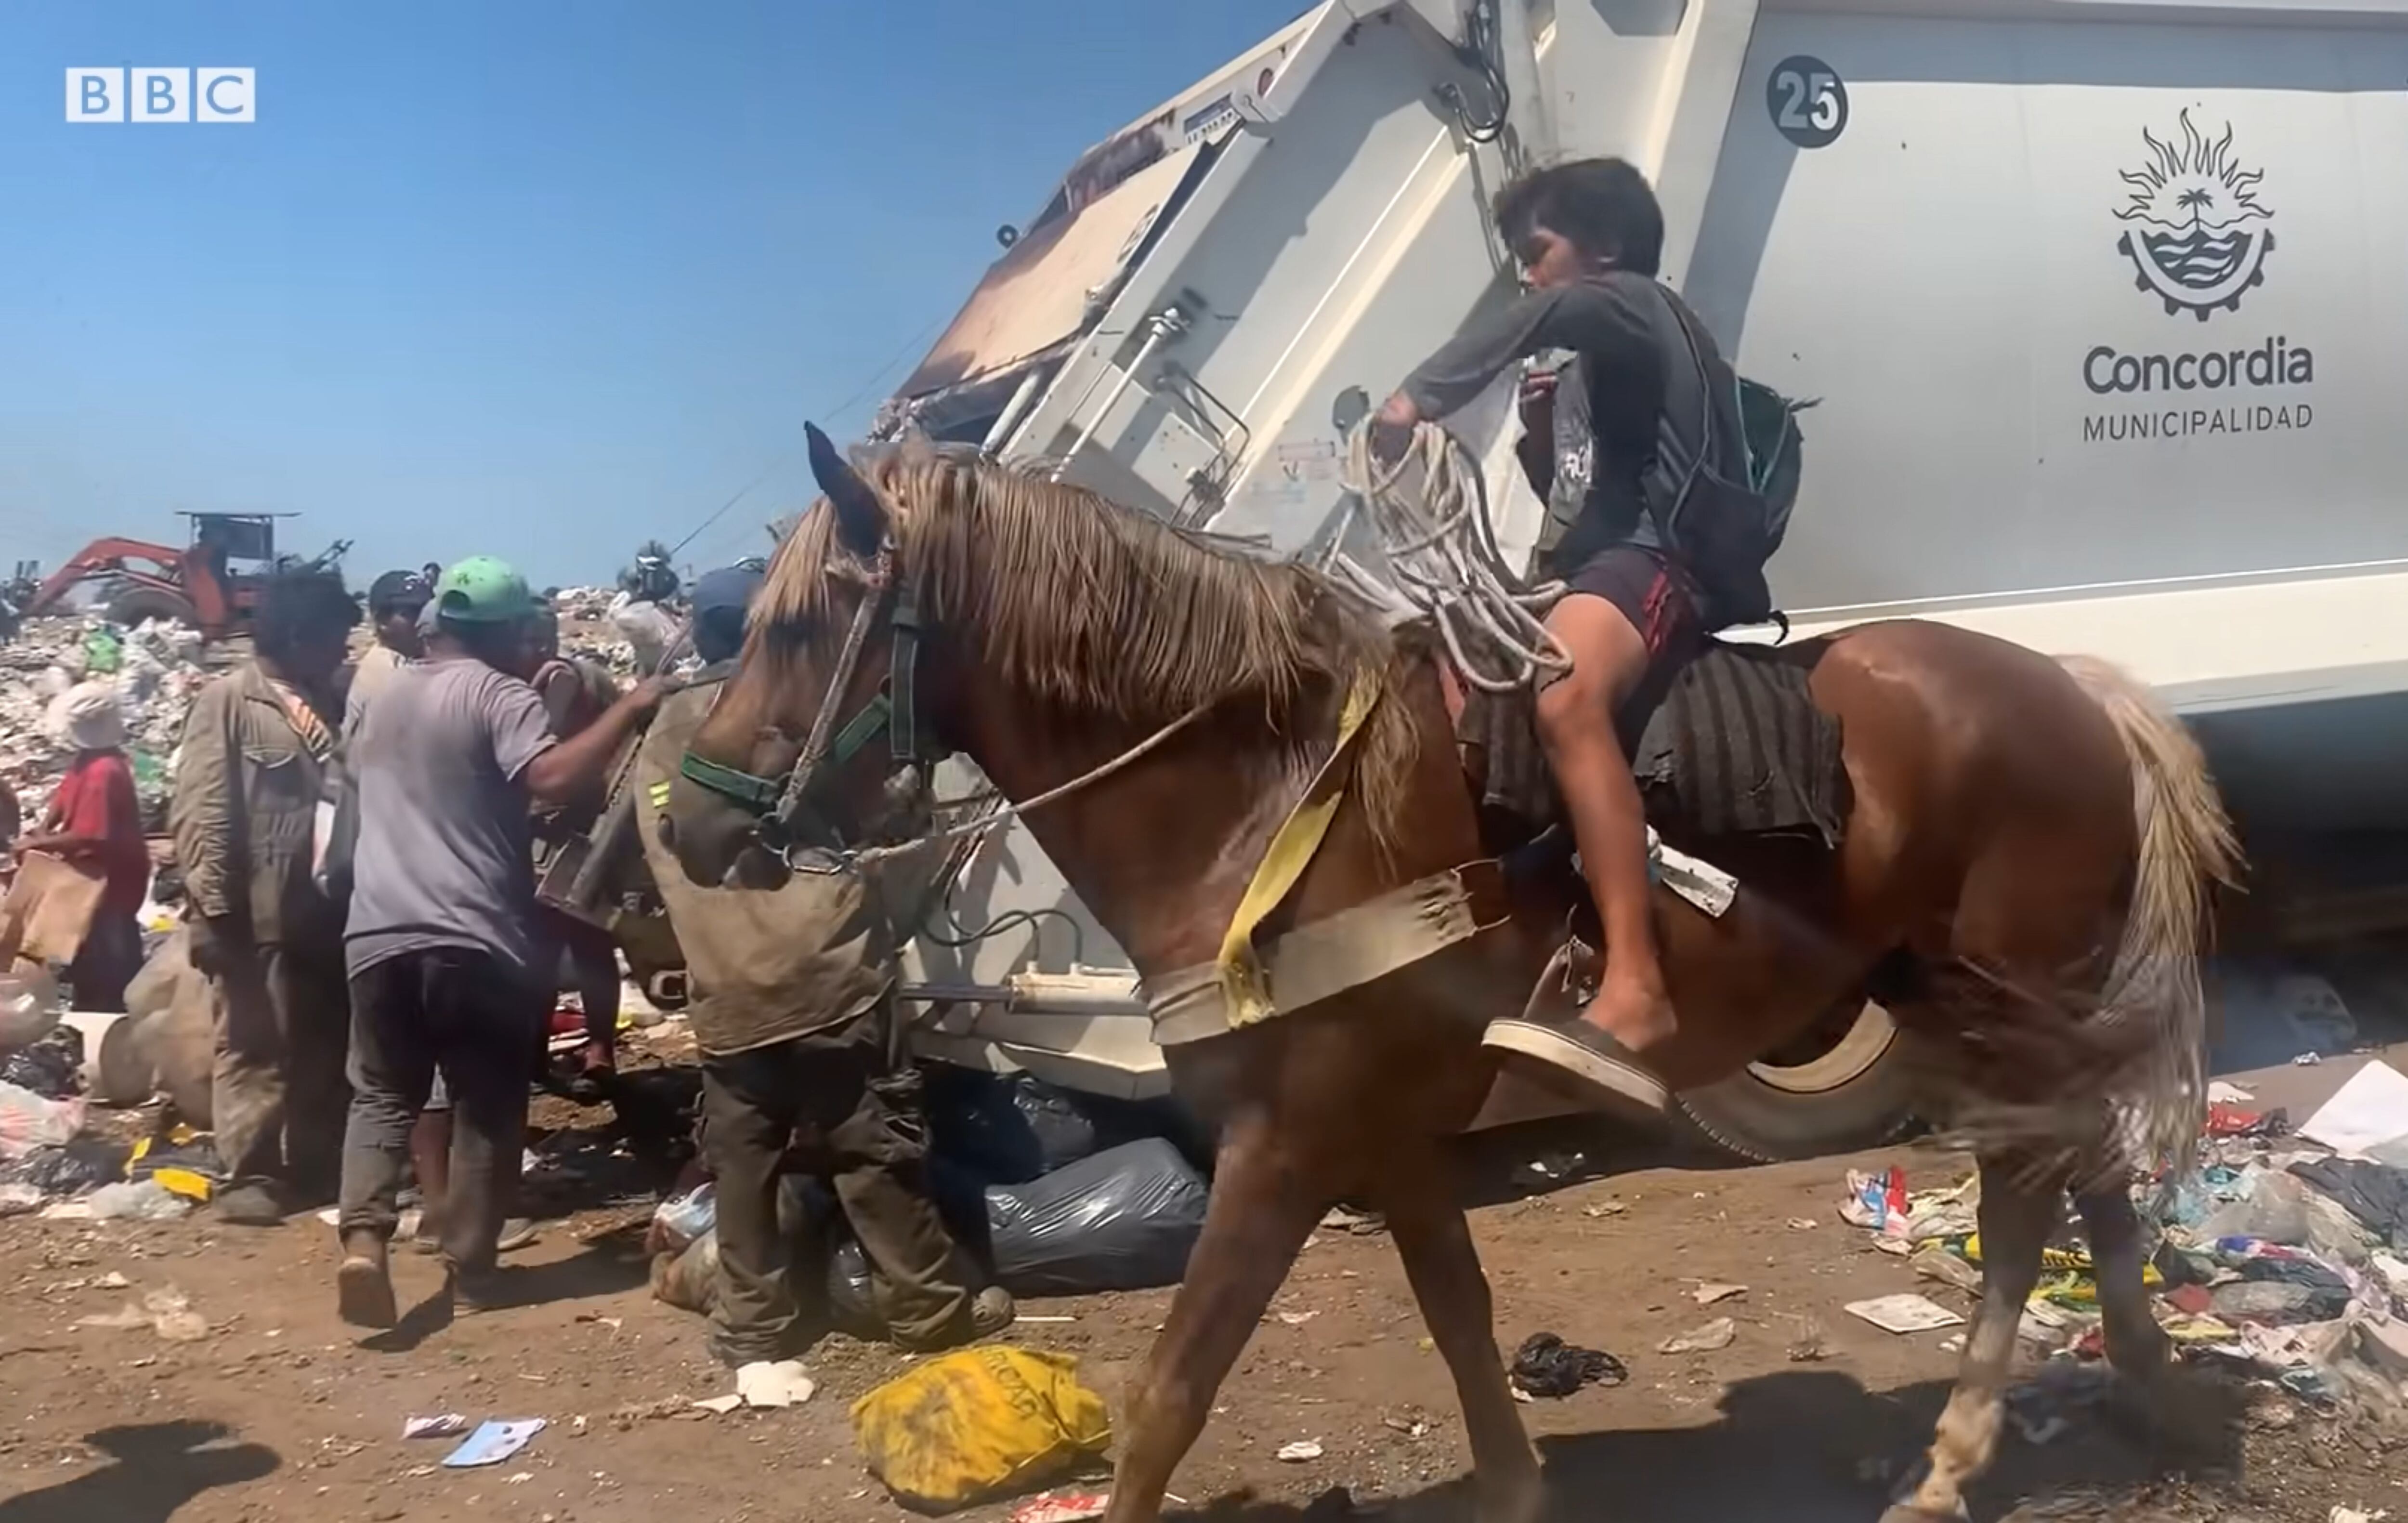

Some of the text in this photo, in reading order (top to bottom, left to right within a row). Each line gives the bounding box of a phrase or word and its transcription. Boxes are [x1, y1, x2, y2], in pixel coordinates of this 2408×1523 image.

[1777, 71, 1839, 130] 25
[2083, 336, 2313, 394] Concordia
[2084, 404, 2313, 442] MUNICIPALIDAD
